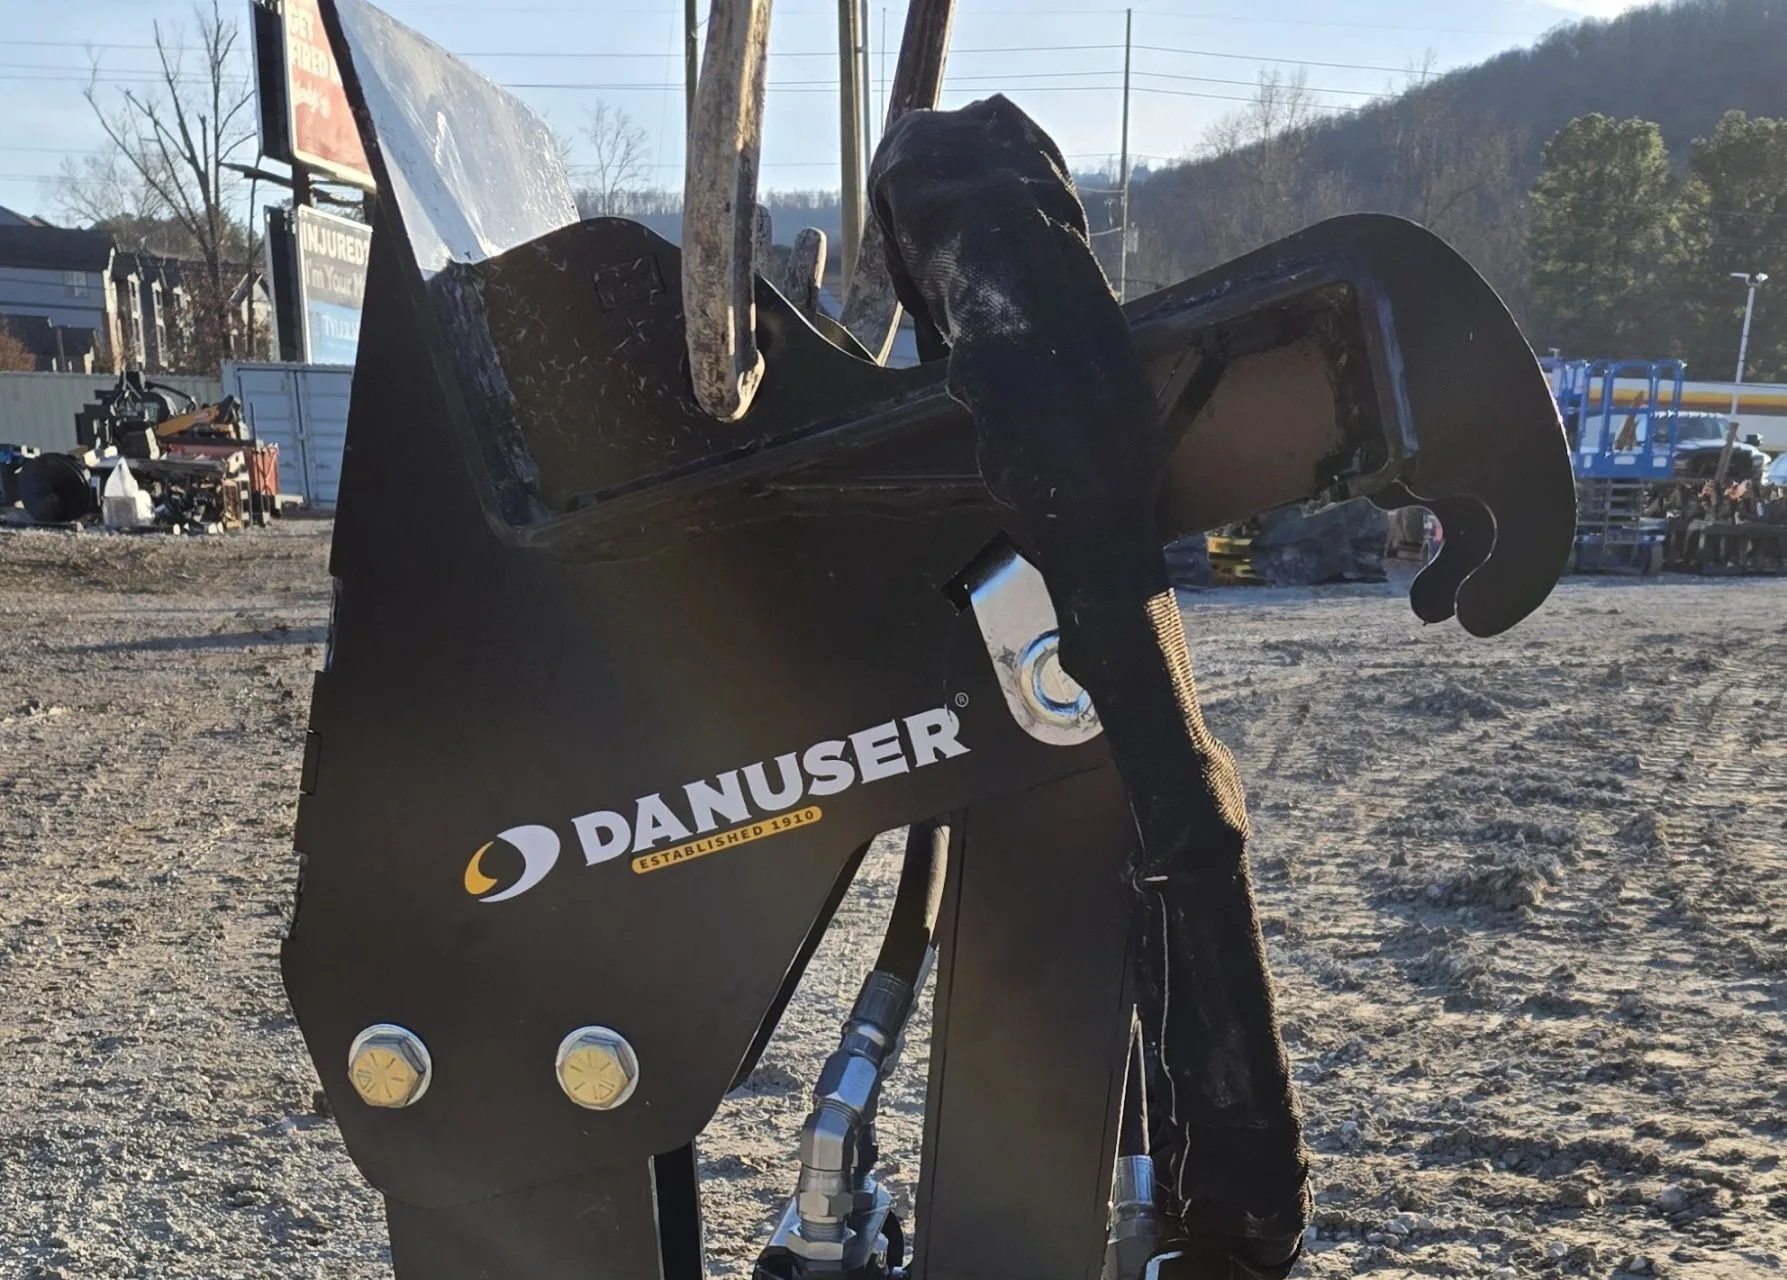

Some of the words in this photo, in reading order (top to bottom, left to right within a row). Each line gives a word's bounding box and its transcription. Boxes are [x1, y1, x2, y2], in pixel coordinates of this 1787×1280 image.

[571, 705, 972, 867] DANUSER
[638, 826, 764, 870] ESTABLISHED
[771, 809, 815, 832] 1910
